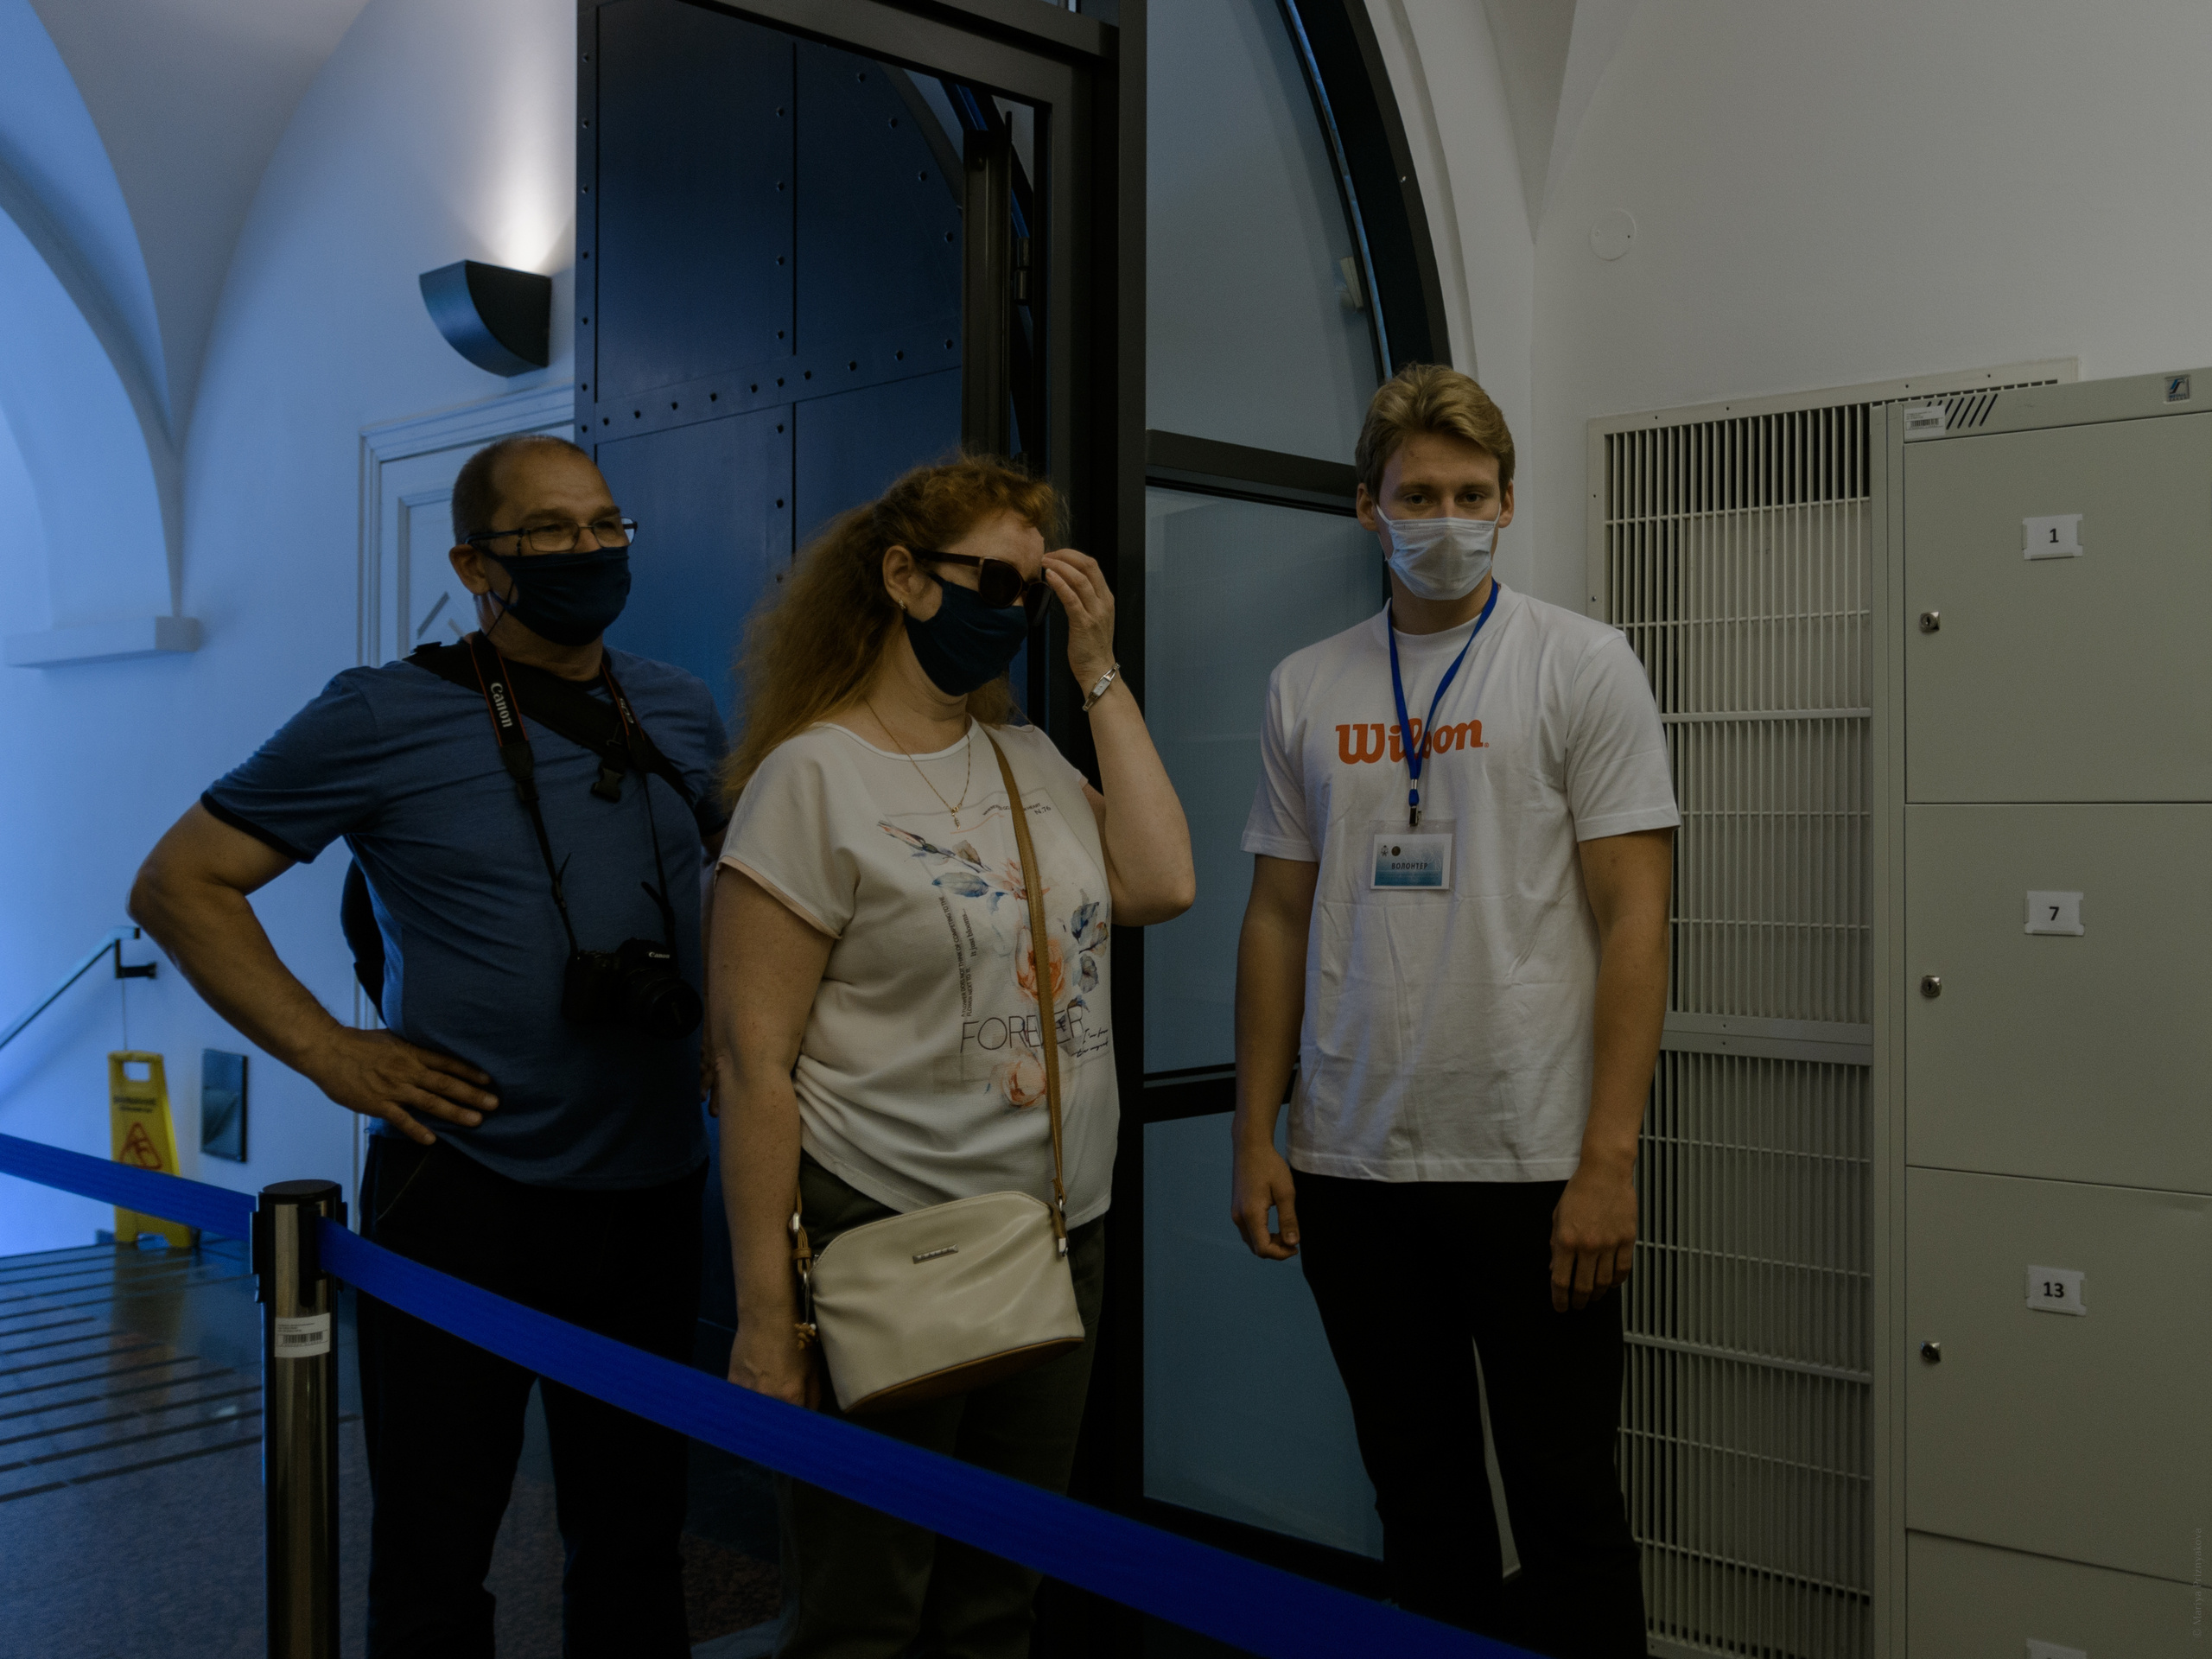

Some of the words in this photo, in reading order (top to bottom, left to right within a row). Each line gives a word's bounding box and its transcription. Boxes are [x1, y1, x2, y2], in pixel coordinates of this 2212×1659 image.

[2049, 528, 2059, 543] 1
[490, 682, 513, 728] Canon
[938, 896, 947, 906] THE
[2049, 906, 2060, 921] 7
[945, 912, 959, 943] COMPETING
[962, 908, 974, 938] blooms...
[955, 943, 962, 951] OF
[969, 938, 977, 950] just
[2043, 1281, 2065, 1298] 13
